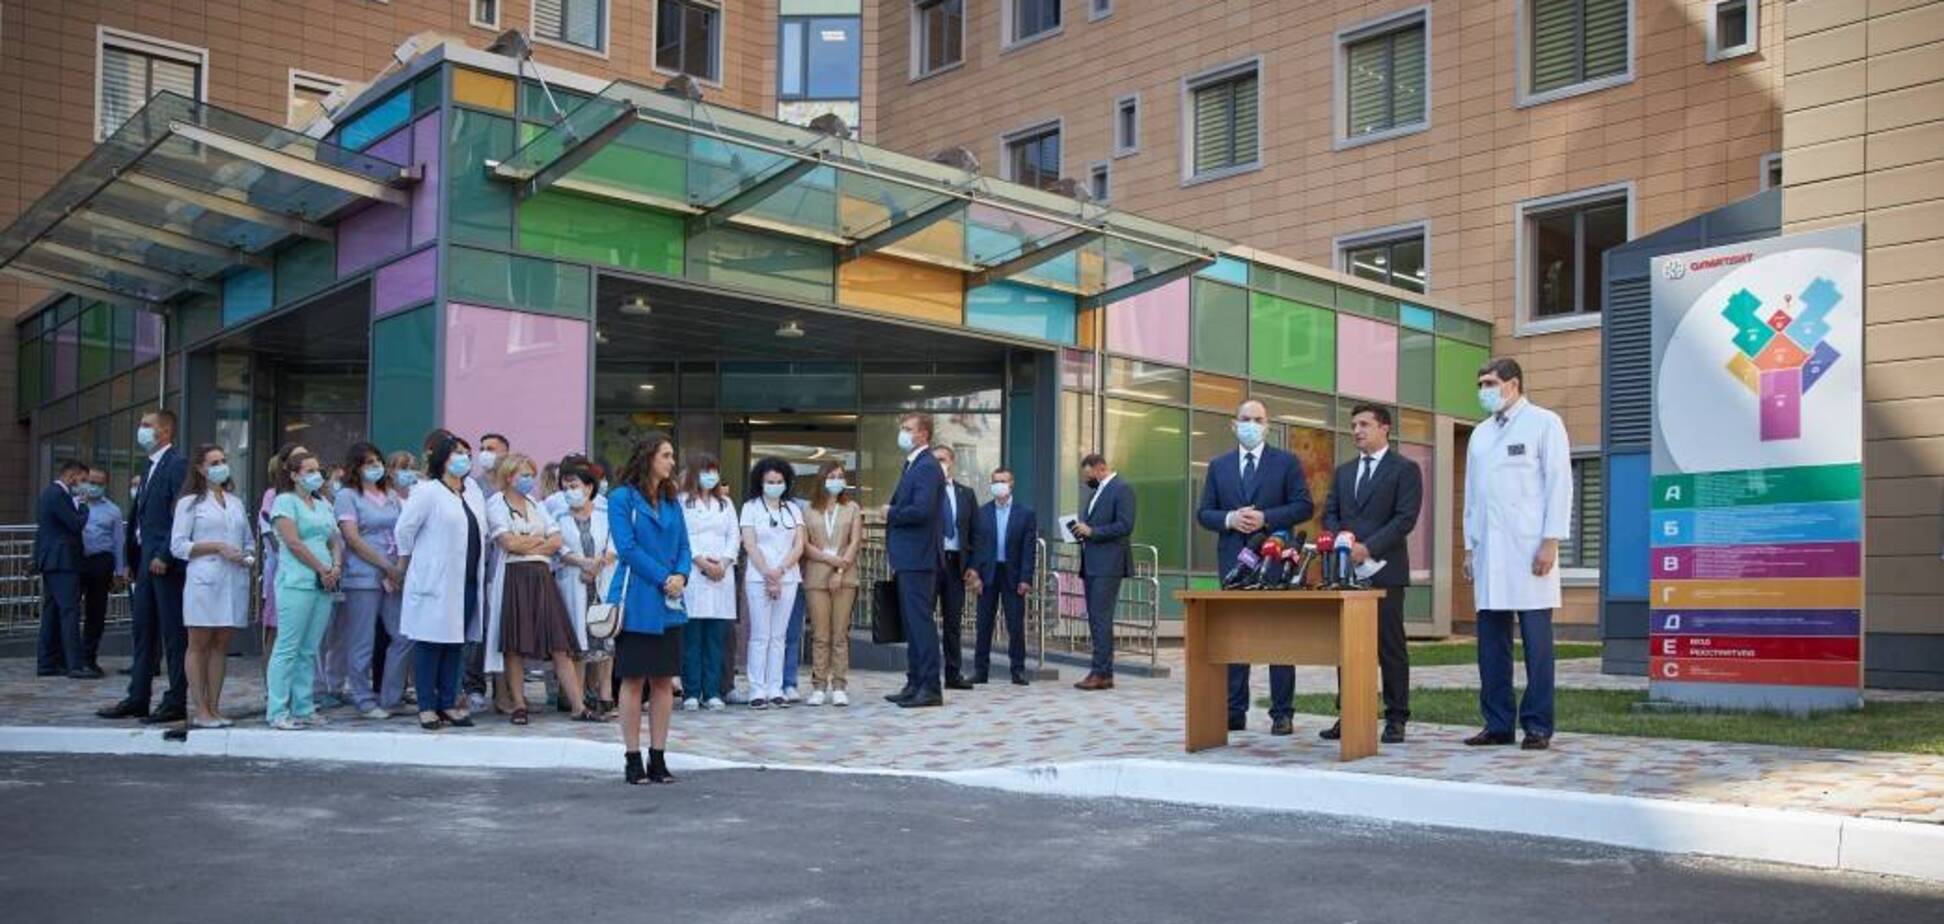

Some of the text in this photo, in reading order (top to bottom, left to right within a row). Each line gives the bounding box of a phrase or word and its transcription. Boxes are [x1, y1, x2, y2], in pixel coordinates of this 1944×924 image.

[1665, 485, 1681, 501] А
[1663, 520, 1679, 536] Б
[1663, 556, 1679, 571] В
[1663, 586, 1676, 602] Г
[1664, 614, 1680, 630] Д
[1663, 639, 1677, 654] Е
[1663, 662, 1679, 677] С
